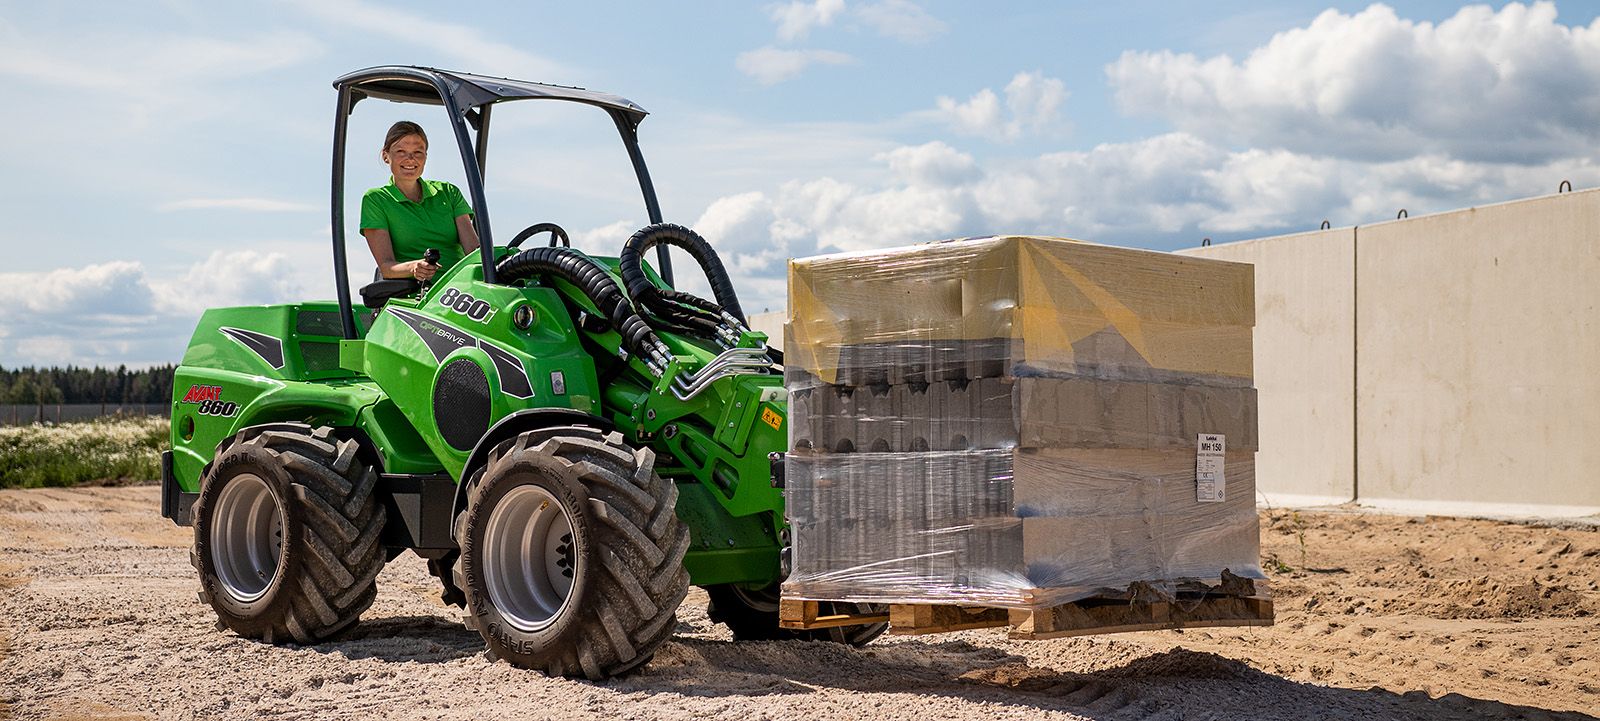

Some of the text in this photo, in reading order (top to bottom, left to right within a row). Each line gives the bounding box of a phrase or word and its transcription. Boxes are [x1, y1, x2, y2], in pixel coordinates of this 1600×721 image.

[439, 287, 498, 324] 860i
[420, 321, 466, 346] OPTIDRIVE
[181, 384, 223, 403] AVANT
[198, 399, 242, 418] 860i
[1201, 443, 1222, 451] MH 150
